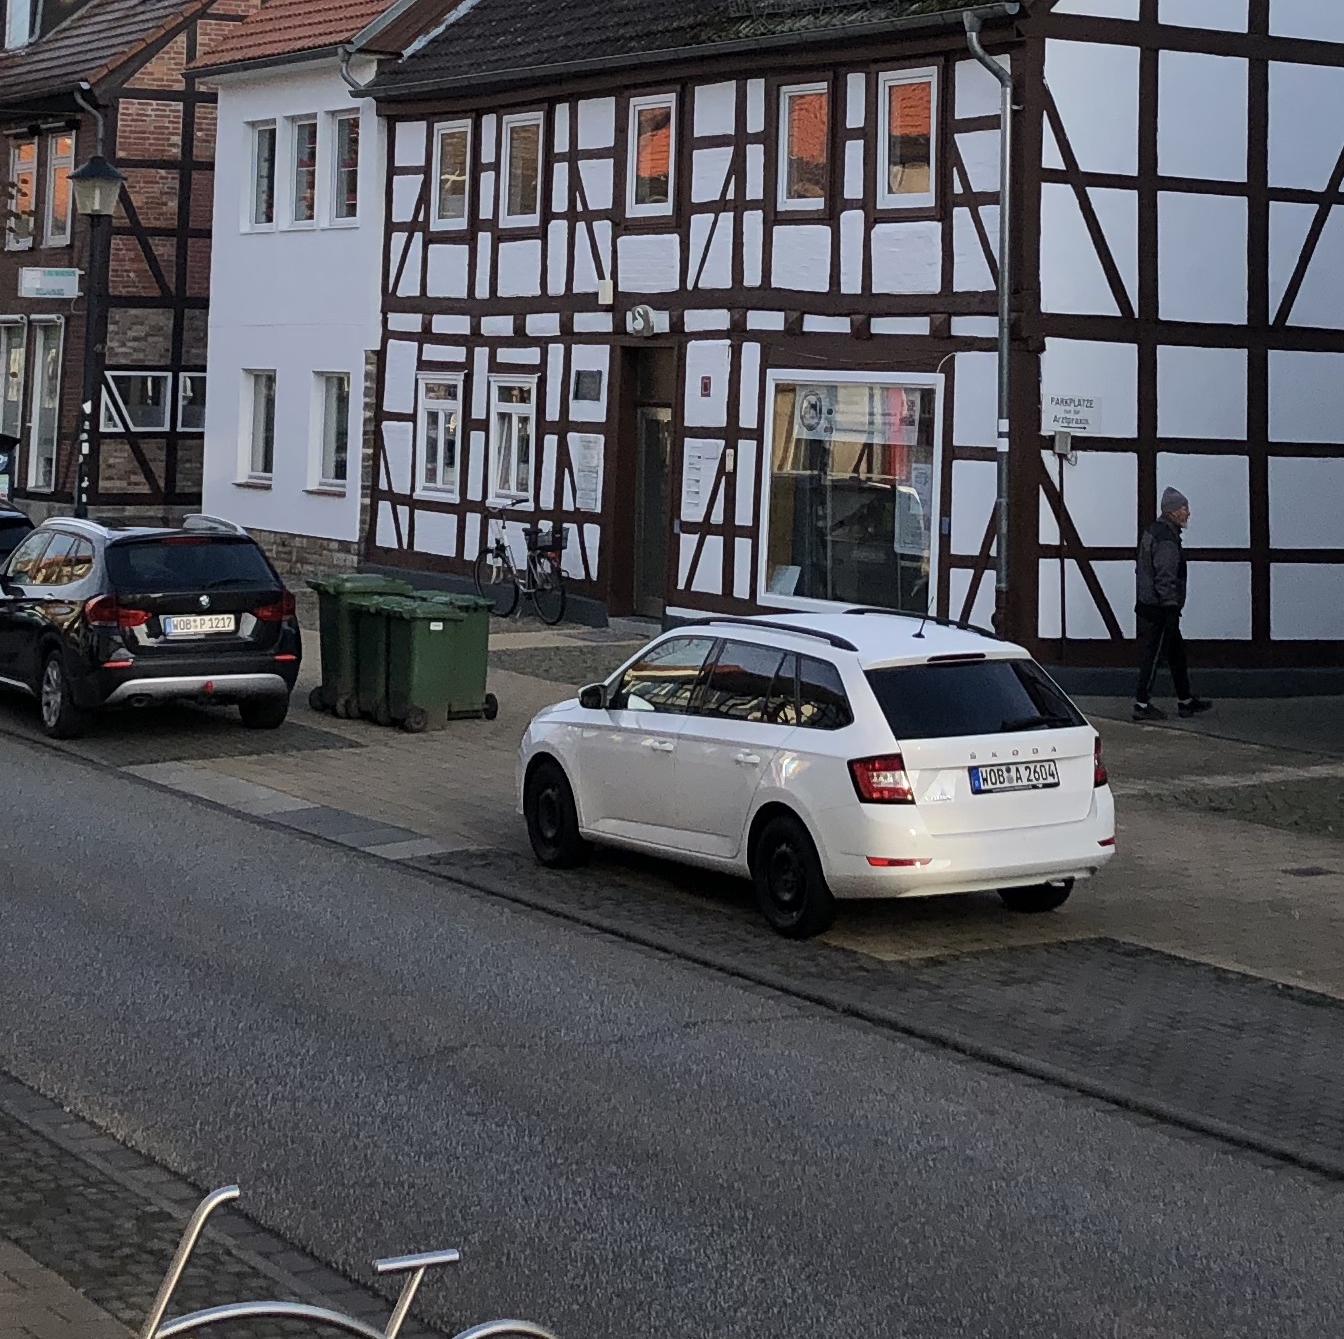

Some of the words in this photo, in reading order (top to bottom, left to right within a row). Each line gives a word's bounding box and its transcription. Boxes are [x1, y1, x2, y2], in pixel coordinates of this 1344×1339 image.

[173, 619, 191, 630] WOB
[200, 618, 205, 629] P
[208, 617, 232, 629] 1217
[981, 767, 1005, 786] WOB
[1015, 766, 1024, 784] A
[1025, 764, 1056, 782] 2604
